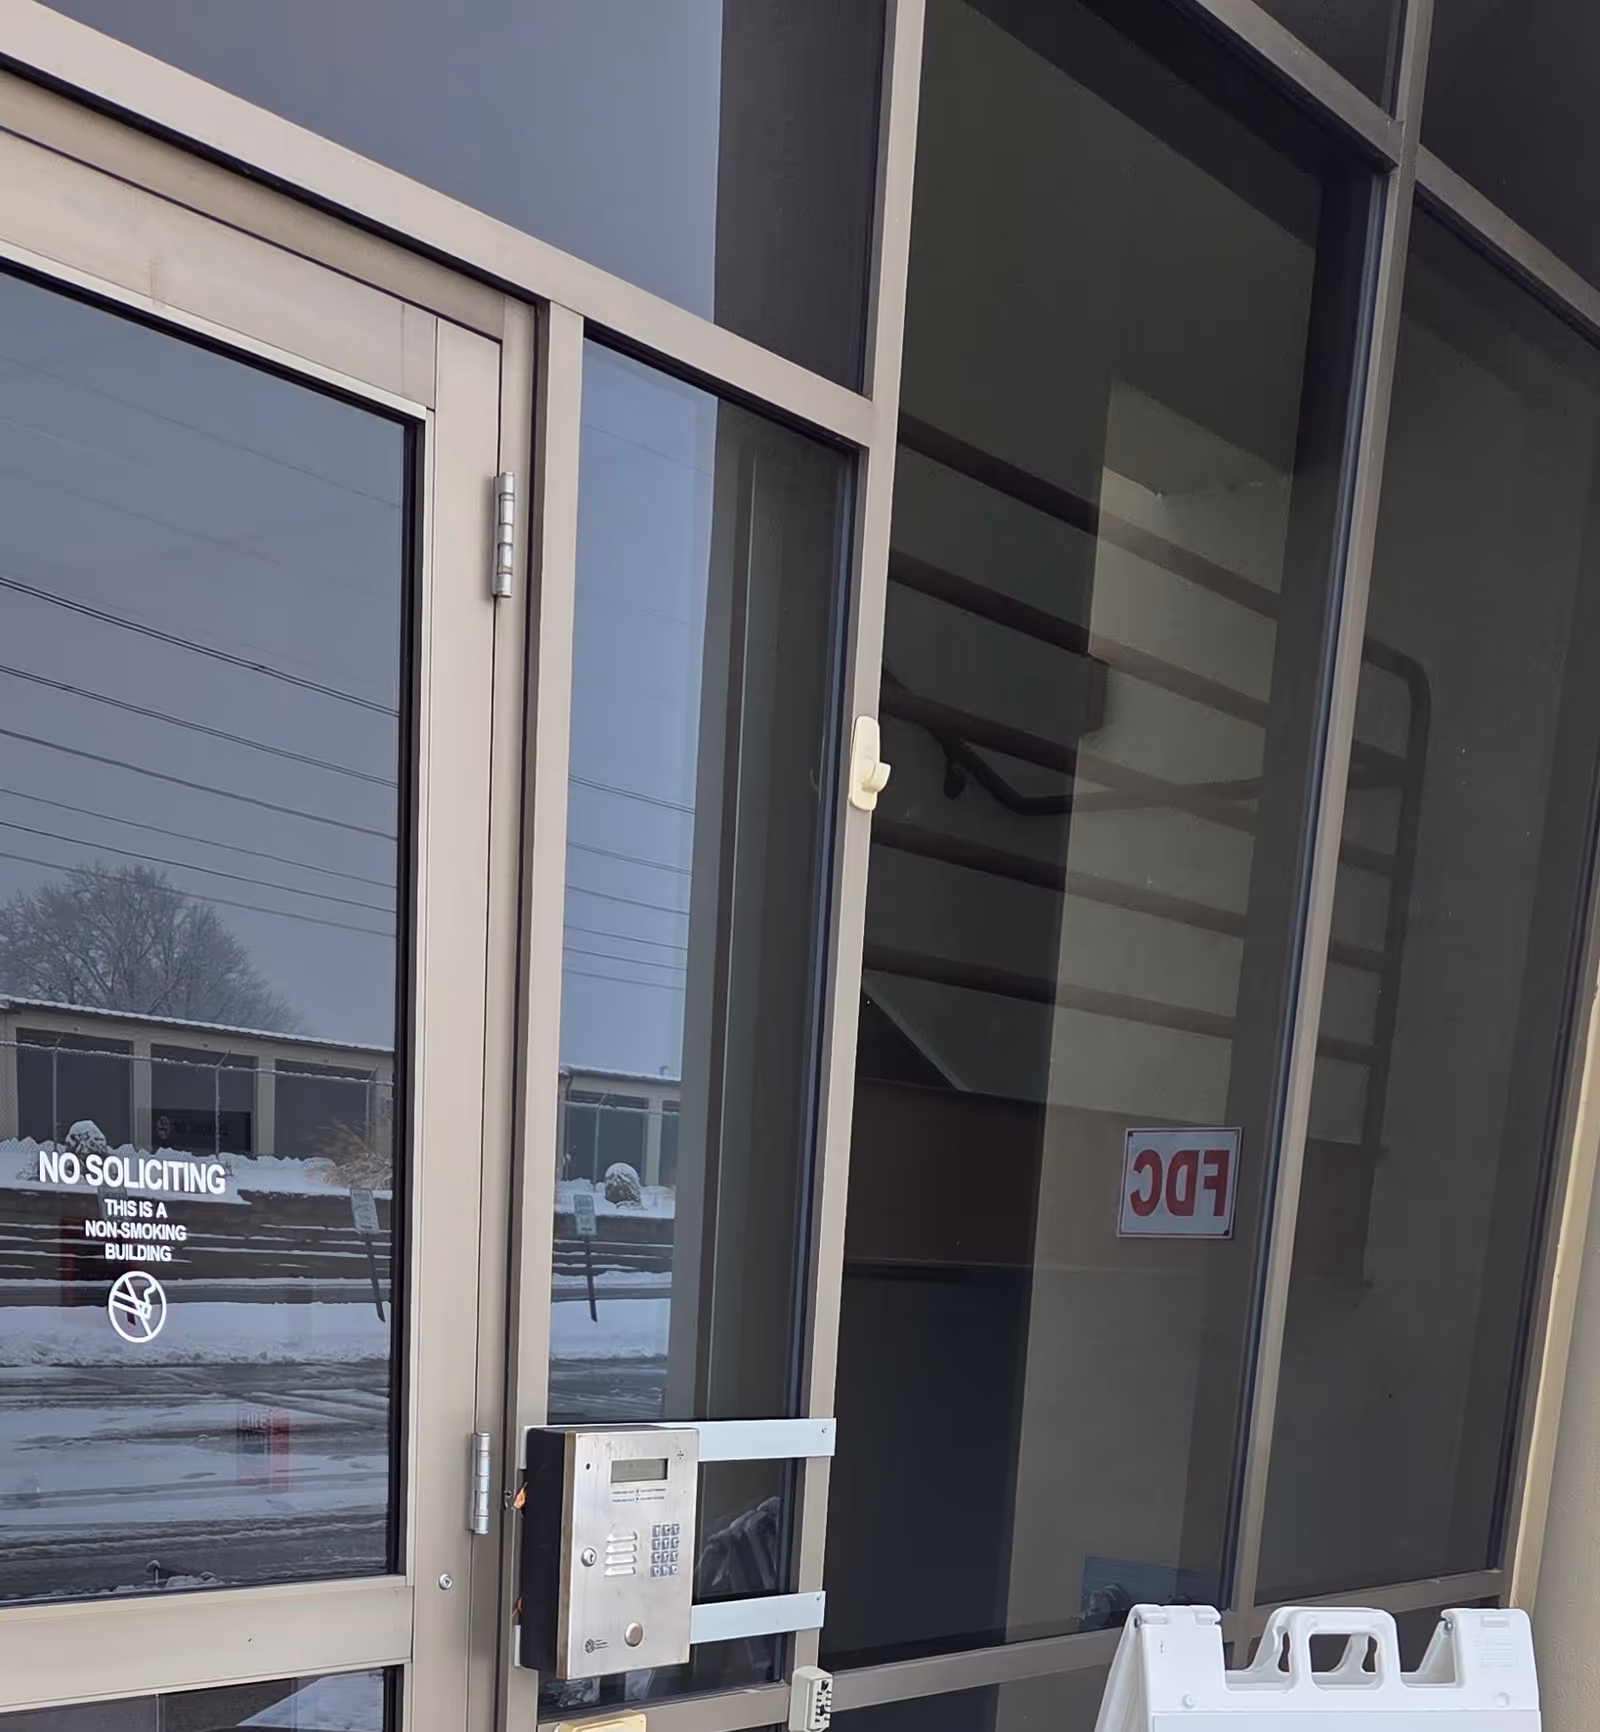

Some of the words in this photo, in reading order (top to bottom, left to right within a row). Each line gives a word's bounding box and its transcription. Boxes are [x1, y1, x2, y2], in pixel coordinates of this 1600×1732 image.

[39, 1150, 81, 1184] NO
[85, 1154, 226, 1195] SOLICITING
[104, 1199, 137, 1217] THIS
[139, 1201, 153, 1218] IS
[156, 1202, 168, 1218] A
[85, 1220, 187, 1241] NON-SMOKING
[104, 1243, 172, 1262] BUILDING
